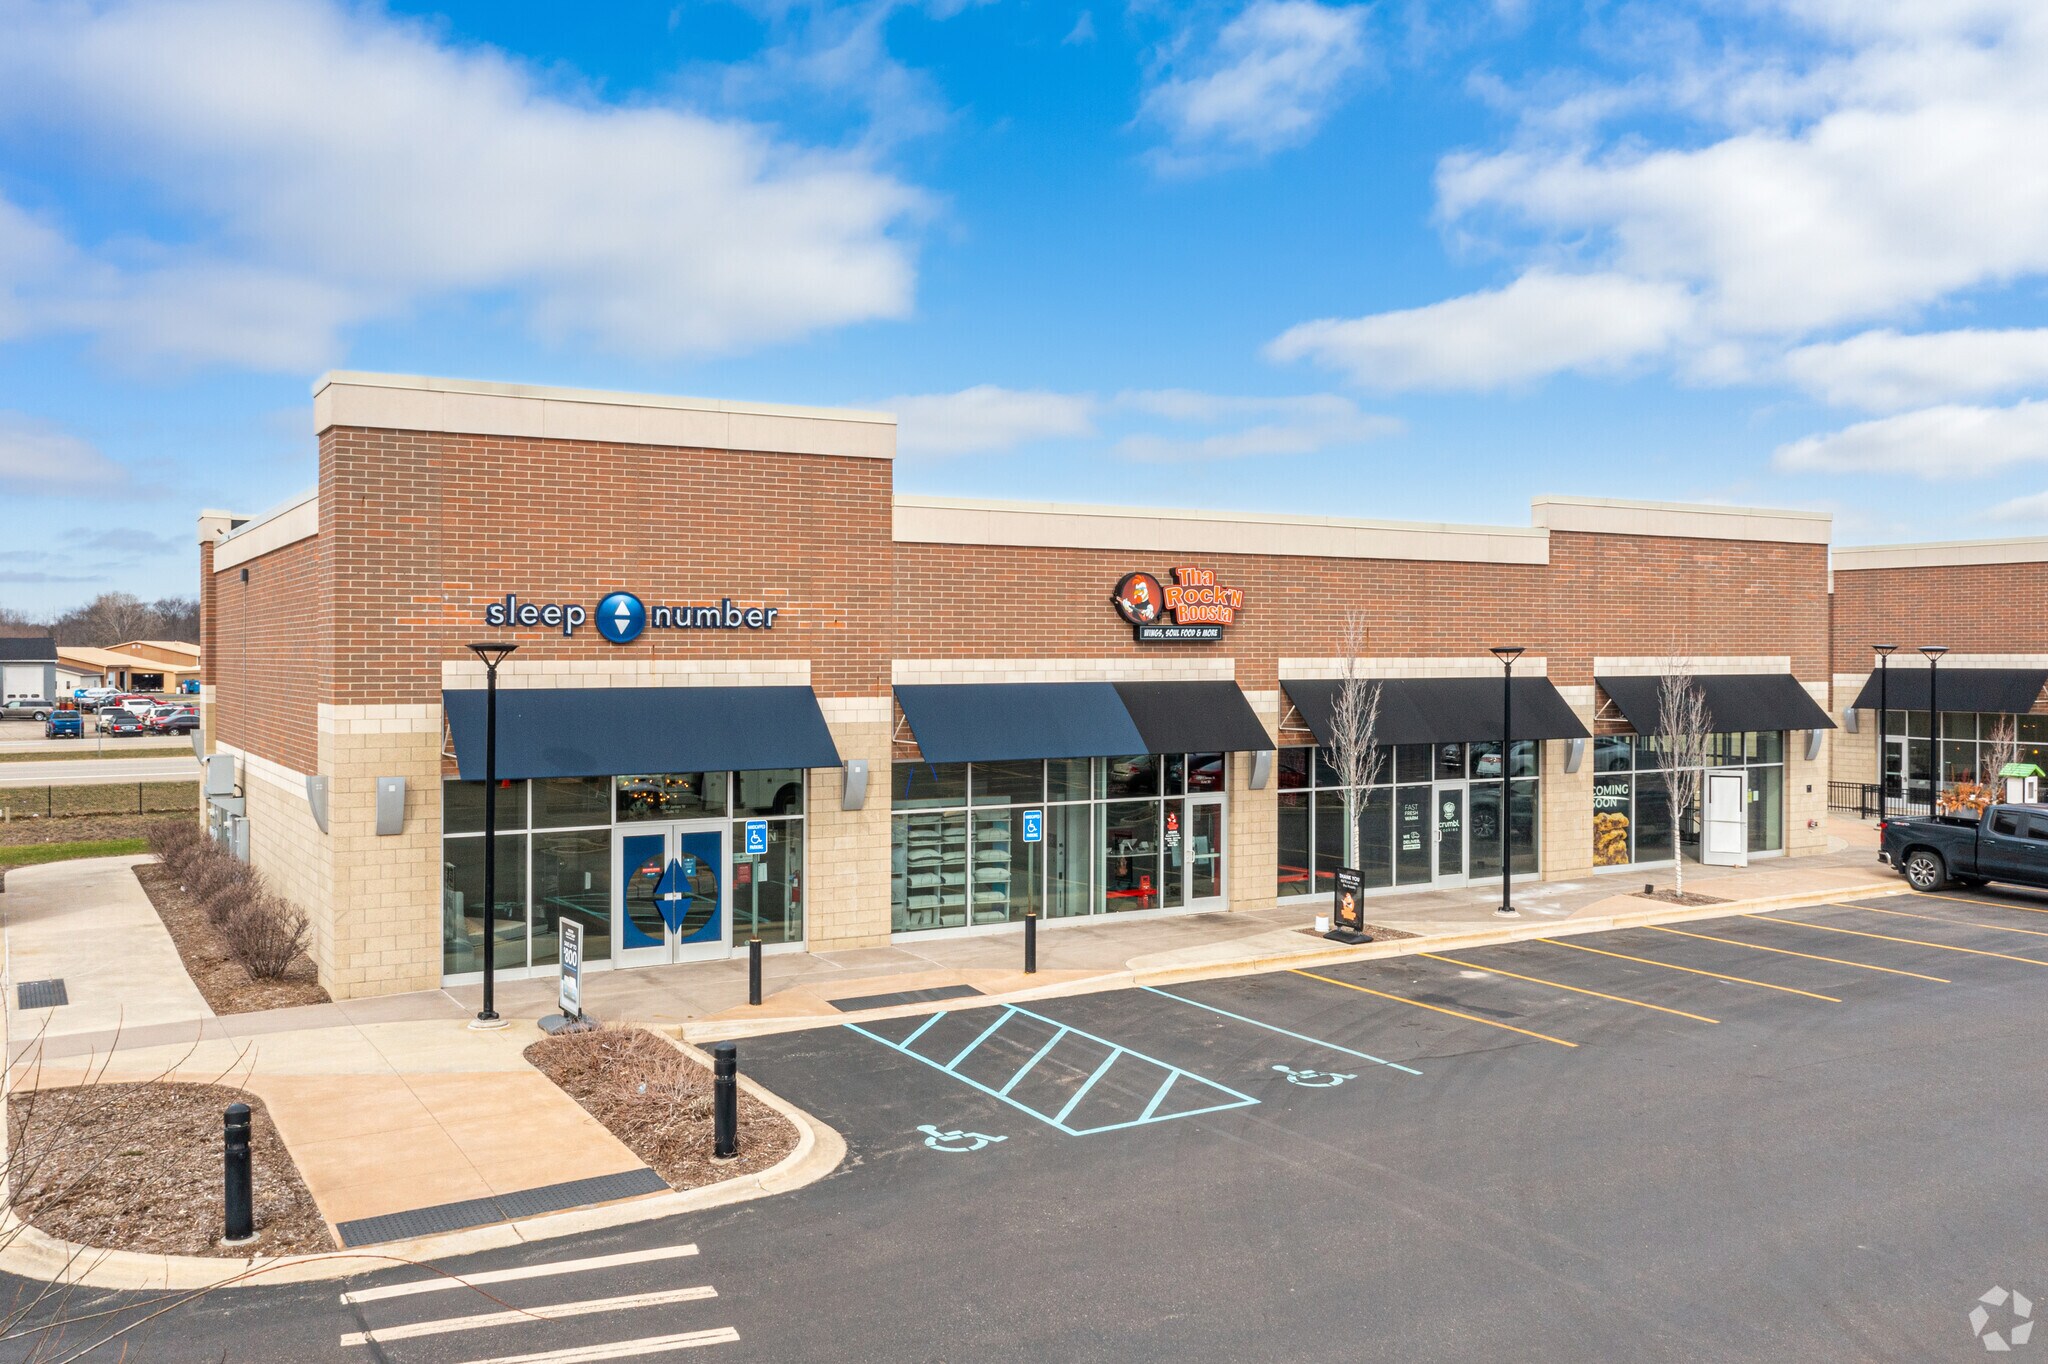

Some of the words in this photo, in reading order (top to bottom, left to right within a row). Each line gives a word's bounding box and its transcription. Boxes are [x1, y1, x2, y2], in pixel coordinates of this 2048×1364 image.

[1177, 567, 1214, 587] Tha
[1165, 585, 1243, 608] Rock'N
[486, 594, 586, 636] sleep
[652, 597, 778, 629] number
[1177, 604, 1233, 623] Roosta
[1165, 629, 1179, 637] SOUL
[1180, 629, 1195, 637] FOOD
[1196, 629, 1201, 637] &
[1202, 629, 1218, 637] MORE
[1404, 803, 1418, 811] FAST
[1339, 873, 1352, 881] THANK
